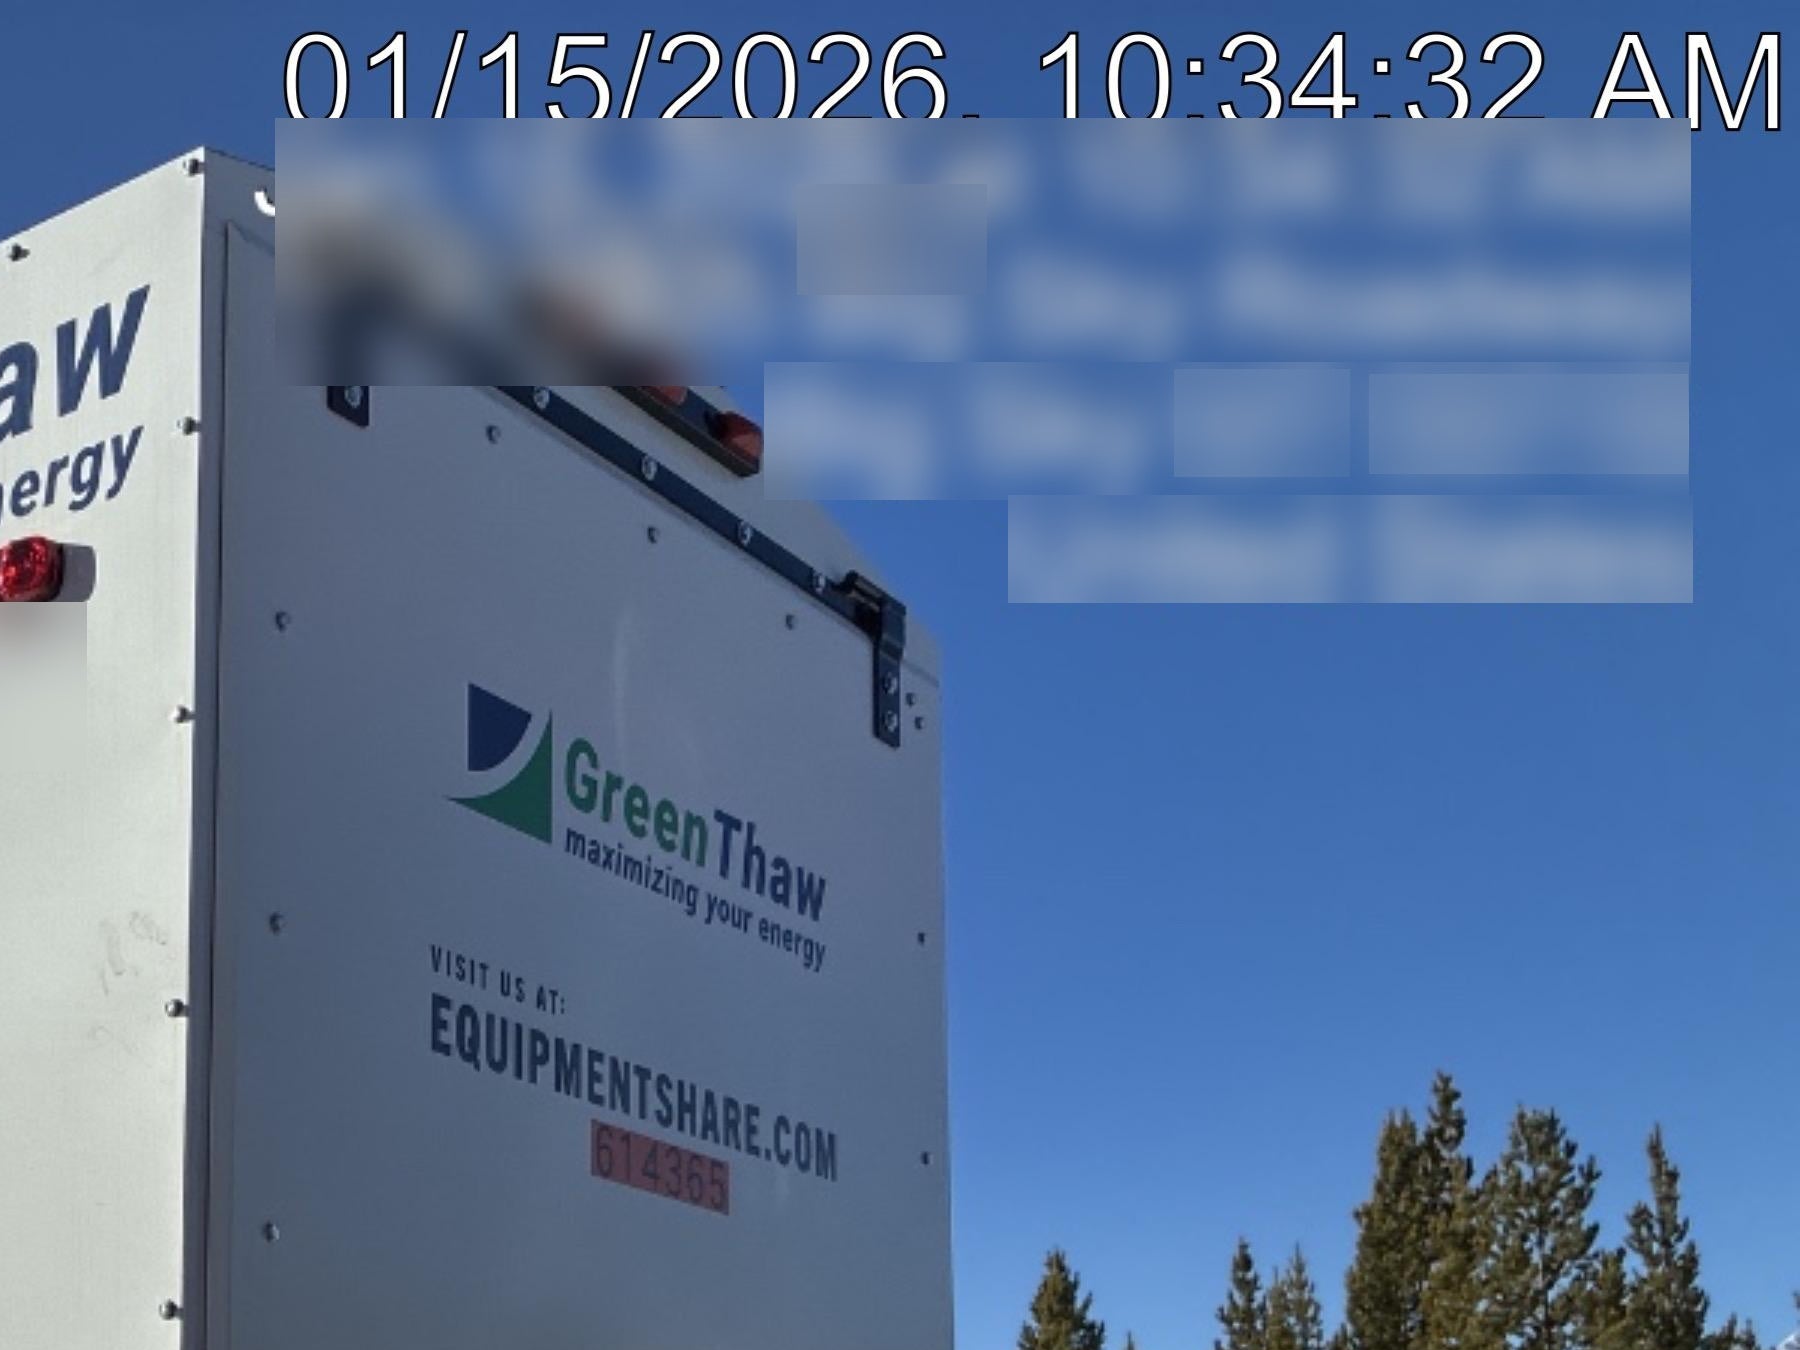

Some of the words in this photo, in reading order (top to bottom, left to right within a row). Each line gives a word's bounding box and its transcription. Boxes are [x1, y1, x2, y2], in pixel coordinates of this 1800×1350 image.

[564, 826, 700, 918] maximizing
[704, 892, 753, 934] your
[758, 916, 827, 973] energy
[430, 944, 489, 991] VISIT
[500, 969, 526, 1003] US
[536, 985, 566, 1016] AT:
[430, 992, 839, 1182] EQUIPMENTSHARE.COM
[595, 1122, 726, 1212] 614365
